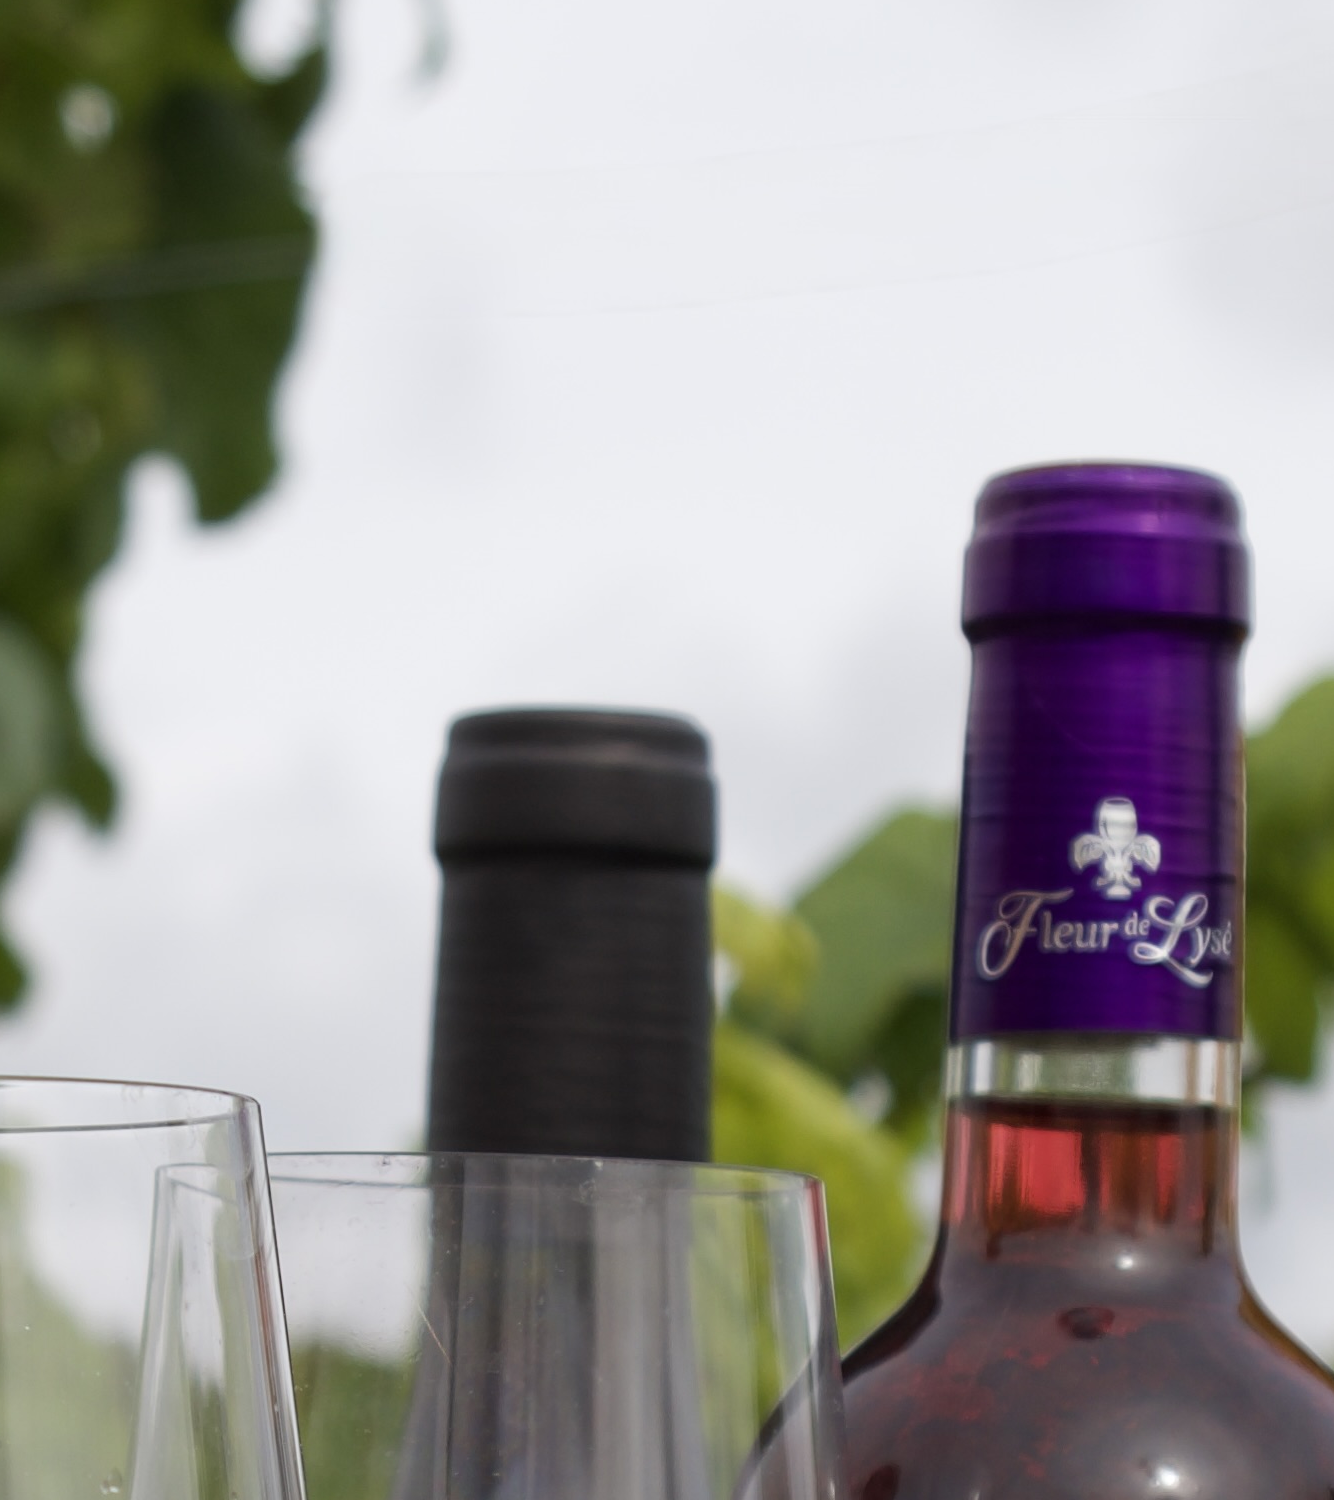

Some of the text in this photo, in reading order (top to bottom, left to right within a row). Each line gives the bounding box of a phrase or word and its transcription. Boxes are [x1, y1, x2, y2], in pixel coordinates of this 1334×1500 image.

[980, 887, 1233, 989] Fleur de Lysé
